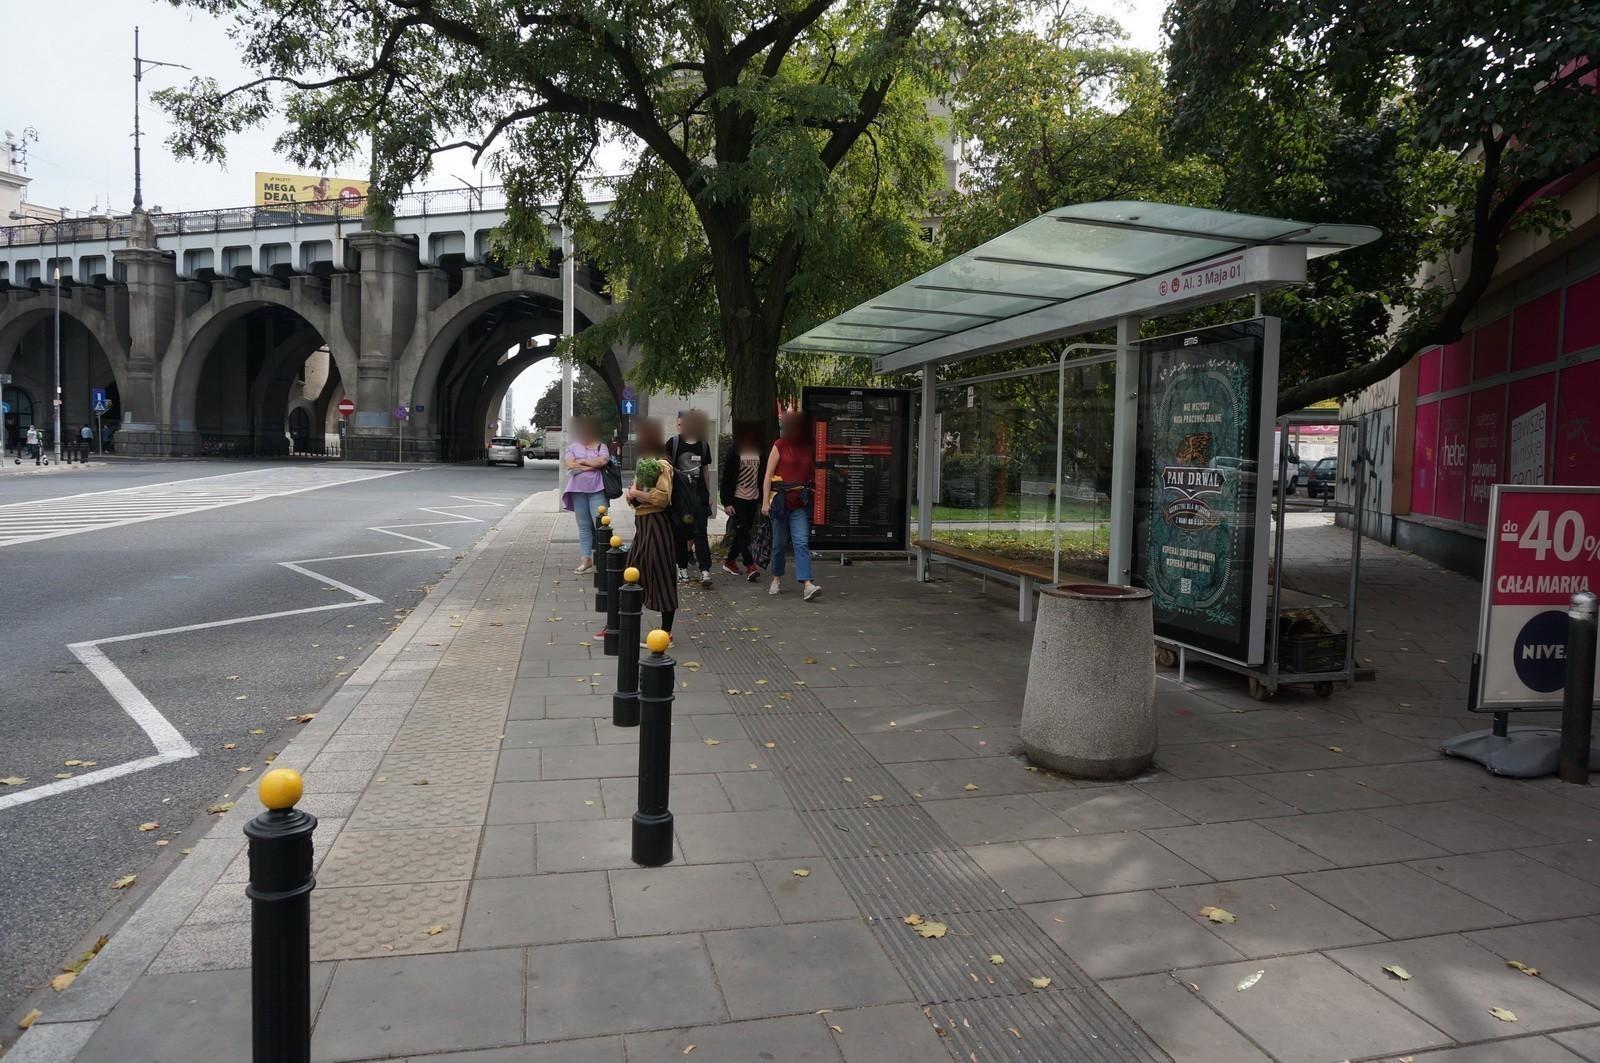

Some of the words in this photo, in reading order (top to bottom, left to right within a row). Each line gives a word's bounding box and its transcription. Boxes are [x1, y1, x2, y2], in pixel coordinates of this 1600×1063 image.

[264, 183, 296, 192] MEGA
[264, 192, 296, 202] DEAL
[1183, 279, 1195, 291] Al.
[1198, 275, 1203, 287] 3
[1205, 270, 1228, 286] Maja
[1230, 264, 1241, 279] 01
[1183, 336, 1199, 346] ams
[1512, 410, 1544, 442] zawsze
[1443, 435, 1465, 466] hebe
[1472, 458, 1496, 477] zdrowia
[1167, 471, 1184, 485] PAN
[1188, 472, 1219, 487] DRWAL
[1502, 520, 1519, 533] do
[1497, 575, 1535, 593] CAŁA
[1536, 576, 1589, 593] MARKA
[1522, 645, 1567, 660] NIVE
